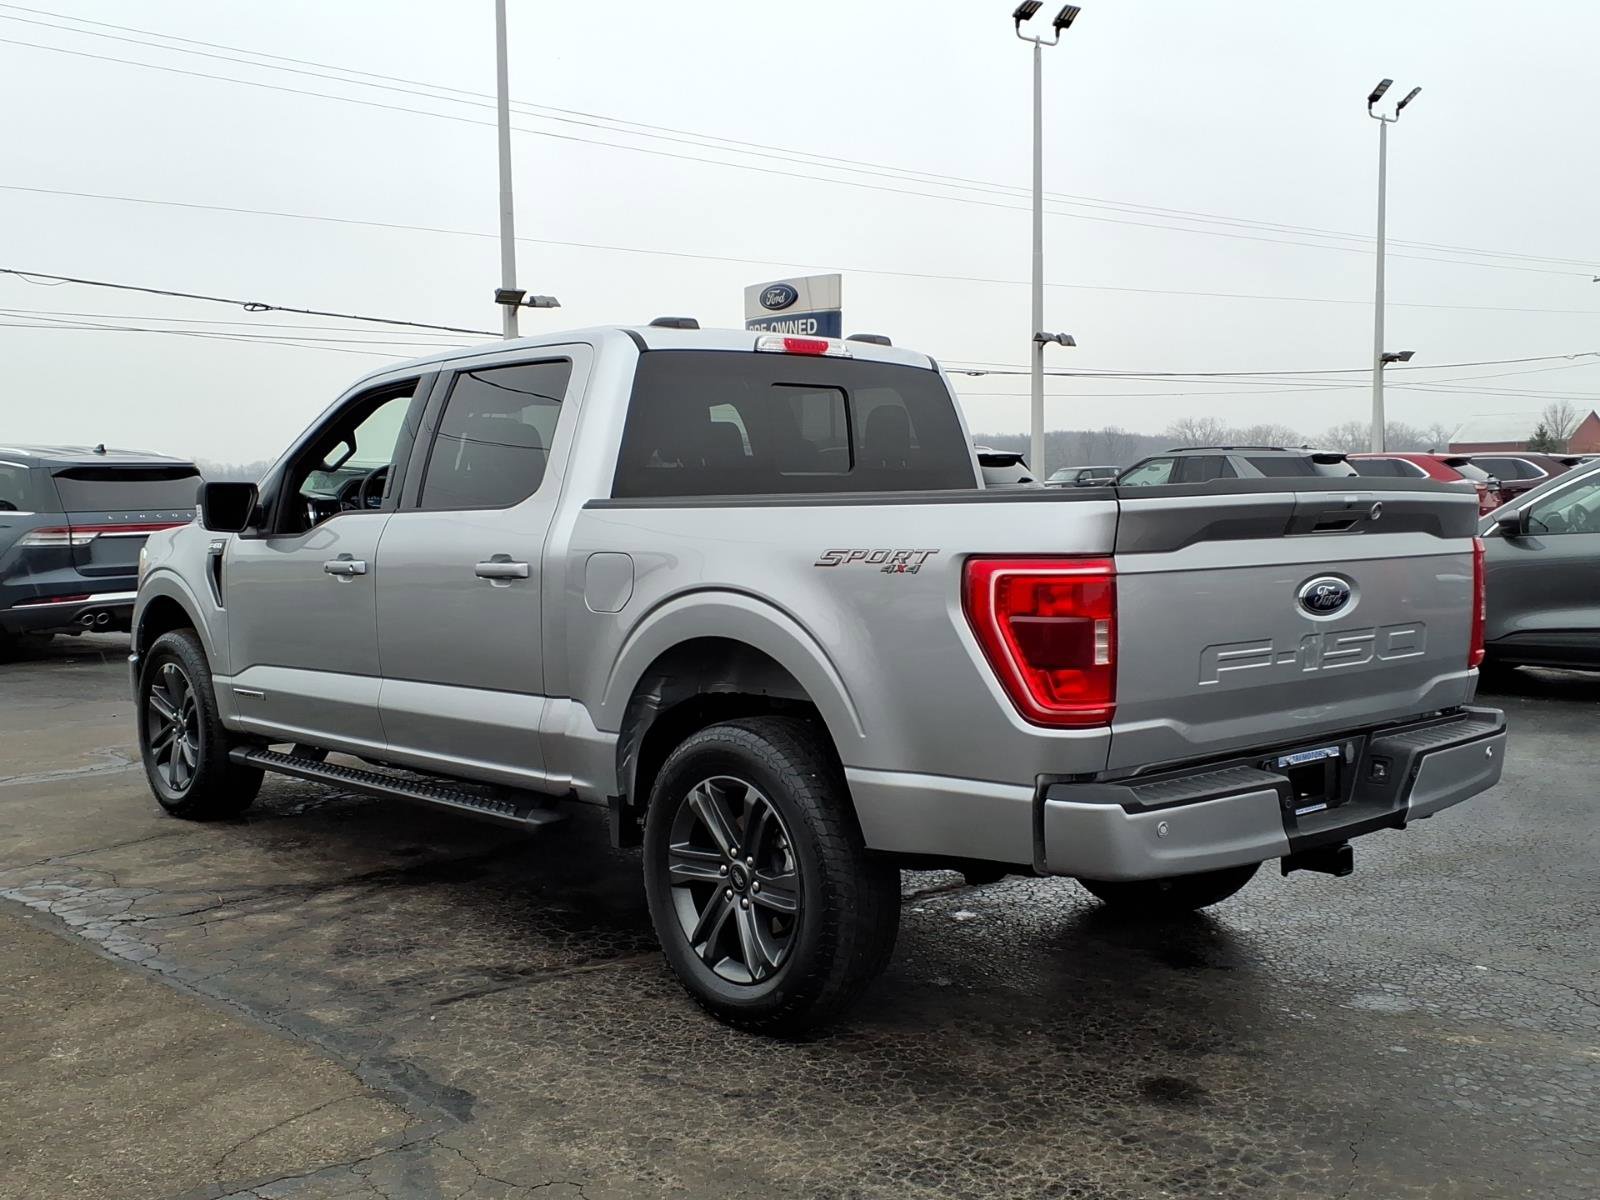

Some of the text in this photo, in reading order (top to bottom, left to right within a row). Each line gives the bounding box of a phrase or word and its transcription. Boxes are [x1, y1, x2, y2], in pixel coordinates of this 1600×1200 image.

[766, 289, 786, 305] Ford
[814, 549, 940, 567] SPORT
[1314, 585, 1344, 607] Ford
[1198, 620, 1426, 685] F-150
